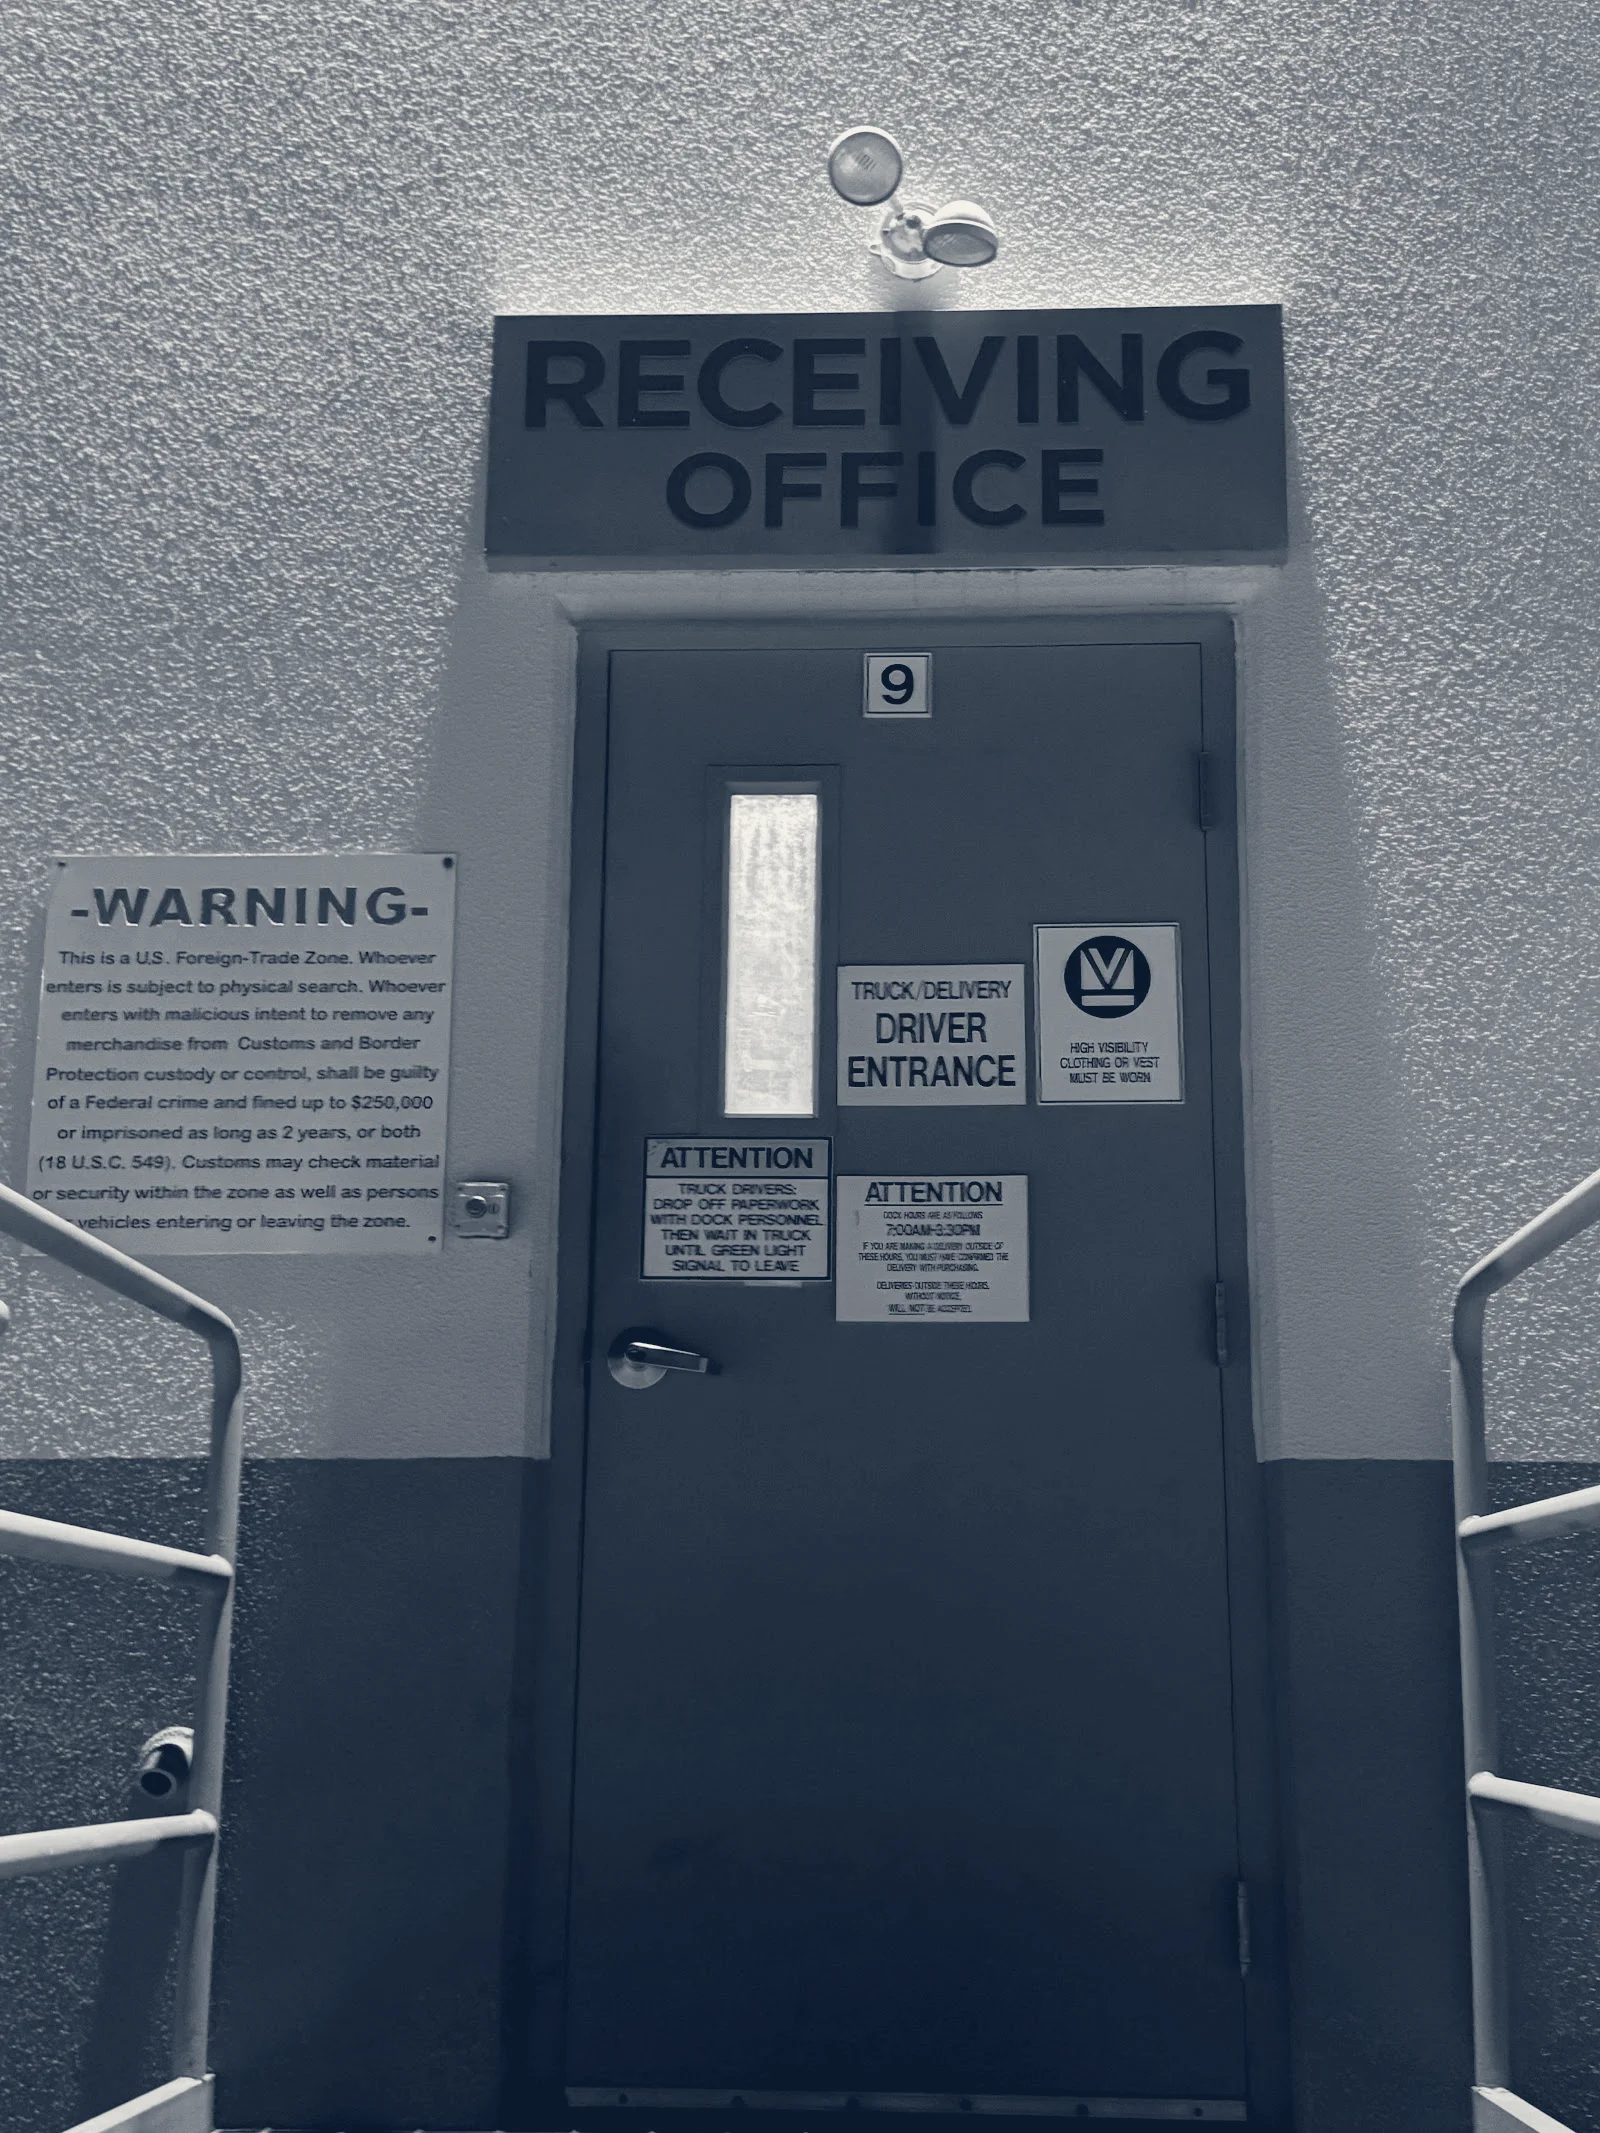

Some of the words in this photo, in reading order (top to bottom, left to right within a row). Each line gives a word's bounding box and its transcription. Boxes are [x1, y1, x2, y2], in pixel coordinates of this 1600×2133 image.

[525, 330, 1250, 428] RECEIVING
[666, 449, 1104, 530] OFFICE
[882, 663, 914, 705] 9
[71, 886, 428, 926] -WARNING-
[59, 951, 94, 965] This
[101, 951, 114, 965] is
[120, 954, 130, 965] a
[136, 951, 169, 965] U.S.
[176, 951, 299, 968] Foreign-Trade
[304, 951, 353, 965] Zone.
[358, 951, 436, 965] Whoever
[46, 981, 102, 993] enters
[107, 980, 122, 993] is
[126, 980, 192, 996] subject
[198, 981, 214, 993] to
[219, 980, 293, 996] physical
[298, 980, 363, 993] search.
[369, 980, 446, 993] Whoever
[851, 980, 1012, 1001] TRUCK/DELIVERY
[61, 1008, 118, 1021] enters
[122, 1008, 160, 1021] with
[164, 1008, 250, 1021] malicious
[255, 1008, 305, 1021] intent
[311, 1008, 328, 1021] to
[332, 1009, 398, 1021] remove
[402, 1010, 435, 1024] any
[876, 1012, 987, 1044] DRIVER
[66, 1037, 182, 1051] merchandise
[187, 1037, 228, 1051] from
[237, 1036, 315, 1050] Customs
[320, 1036, 353, 1050] and
[359, 1036, 420, 1050] Border
[1070, 1042, 1095, 1053] HIGH
[1098, 1042, 1148, 1053] VISIBILITY
[848, 1054, 1016, 1088] ENTRANCE
[1060, 1057, 1111, 1069] CLOTHING
[1114, 1057, 1129, 1069] OR
[1134, 1057, 1160, 1069] VEST
[46, 1067, 139, 1081] Protection
[144, 1067, 215, 1083] custody
[220, 1070, 239, 1080] or
[243, 1067, 312, 1081] control,
[316, 1066, 359, 1079] shall
[364, 1066, 385, 1079] be
[390, 1065, 439, 1082] guilty
[1069, 1072, 1098, 1083] MUST
[1102, 1072, 1116, 1083] BE
[1120, 1072, 1151, 1083] WORN
[48, 1096, 66, 1109] of
[69, 1099, 80, 1109] a
[86, 1096, 152, 1109] Federal
[157, 1096, 208, 1109] crime
[214, 1096, 247, 1109] and
[252, 1096, 297, 1109] fined
[302, 1098, 323, 1112] up
[330, 1096, 346, 1109] to
[351, 1095, 433, 1112] $250,000
[57, 1129, 77, 1139] or
[81, 1126, 183, 1142] imprisoned
[188, 1129, 208, 1139] as
[214, 1126, 251, 1143] long
[256, 1128, 277, 1139] as
[282, 1126, 293, 1139] 2
[297, 1128, 351, 1142] years,
[357, 1128, 376, 1139] or
[381, 1124, 420, 1139] both
[38, 1155, 66, 1172] (18
[72, 1156, 125, 1170] U.S.C.
[131, 1156, 175, 1172] 549).
[182, 1155, 260, 1169] Customs
[266, 1157, 303, 1171] may
[308, 1154, 360, 1169] check
[366, 1154, 439, 1169] material
[660, 1146, 813, 1169] ATTENTION
[32, 1190, 51, 1200] or
[56, 1186, 129, 1202] security
[135, 1186, 188, 1200] within
[194, 1186, 221, 1200] the
[226, 1188, 269, 1199] zone
[275, 1188, 295, 1199] as
[301, 1185, 336, 1199] well
[340, 1188, 361, 1199] as
[366, 1187, 439, 1201] persons
[678, 1183, 726, 1195] TRUCK
[732, 1183, 797, 1195] DRIVERS:
[865, 1181, 1003, 1203] ATTENTION
[653, 1199, 693, 1210] DROP
[698, 1199, 727, 1210] OFF
[731, 1199, 820, 1210] PAPERWORK
[79, 1215, 150, 1229] vehicles
[156, 1215, 232, 1231] entering
[237, 1218, 256, 1228] or
[260, 1214, 325, 1231] leaving
[330, 1215, 358, 1229] the
[363, 1217, 410, 1228] zone.
[651, 1214, 687, 1226] WITH
[691, 1214, 733, 1226] DOCK
[738, 1214, 824, 1226] PERSONNEL
[883, 1211, 901, 1219] DOCK
[904, 1211, 925, 1219] HOURS
[661, 1229, 699, 1241] THEN
[704, 1229, 738, 1241] WAIT
[743, 1229, 757, 1241] IN
[763, 1229, 812, 1241] TRUCK
[665, 1245, 706, 1256] UNTIL
[711, 1245, 760, 1256] GREEN
[765, 1245, 806, 1256] LIGHT
[870, 1242, 883, 1250] YOU
[885, 1242, 898, 1250] ARE
[966, 1242, 993, 1250] OUTSIDE
[995, 1242, 1004, 1250] OF
[859, 1252, 879, 1261] THESE
[905, 1252, 918, 1261] YOU
[995, 1252, 1009, 1261] THE
[672, 1260, 725, 1272] SIGNAL
[730, 1260, 750, 1272] TO
[755, 1260, 800, 1272] LEAVE
[887, 1263, 916, 1271] DELIVERY
[920, 1263, 935, 1271] WITH
